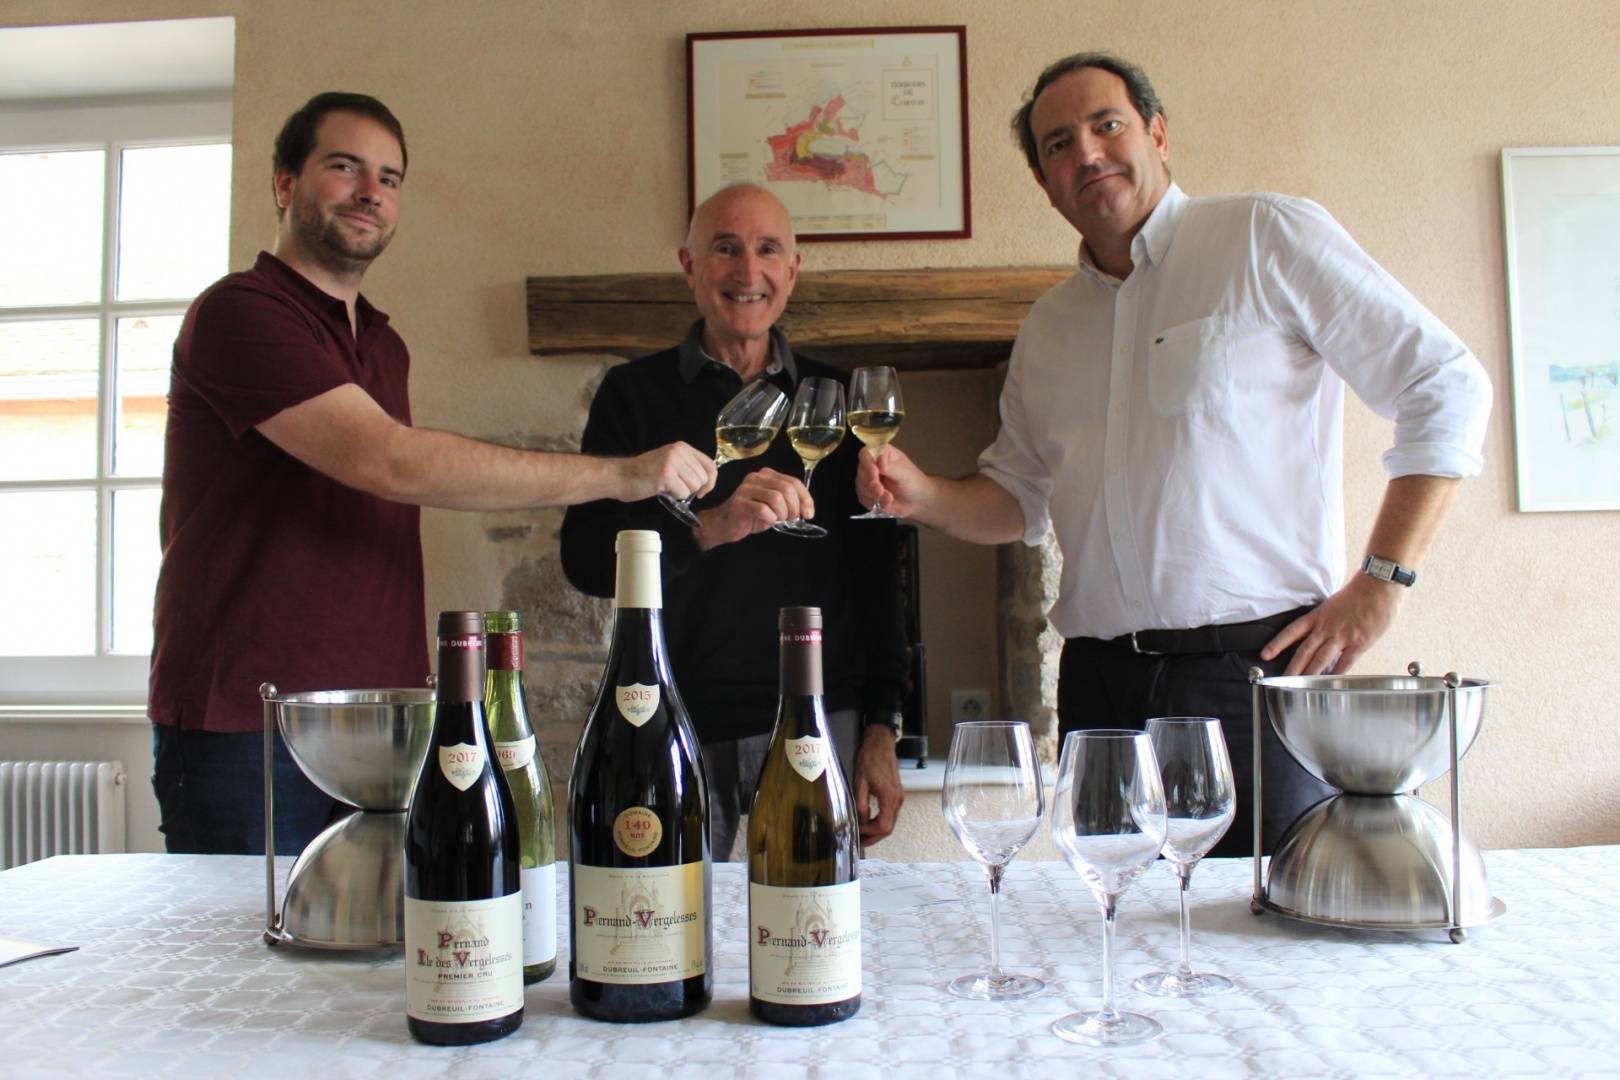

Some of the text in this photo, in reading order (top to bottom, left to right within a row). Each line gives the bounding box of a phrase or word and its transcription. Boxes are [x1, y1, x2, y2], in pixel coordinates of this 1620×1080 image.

[623, 690, 651, 701] 2015
[794, 744, 821, 755] 2017
[448, 752, 477, 764] 2017
[624, 820, 651, 830] 140
[583, 905, 697, 930] Pernand-Vergelesses
[437, 930, 490, 950] Pernand
[435, 956, 451, 969] des
[603, 963, 679, 974] DUBREUIL-FONTAINE
